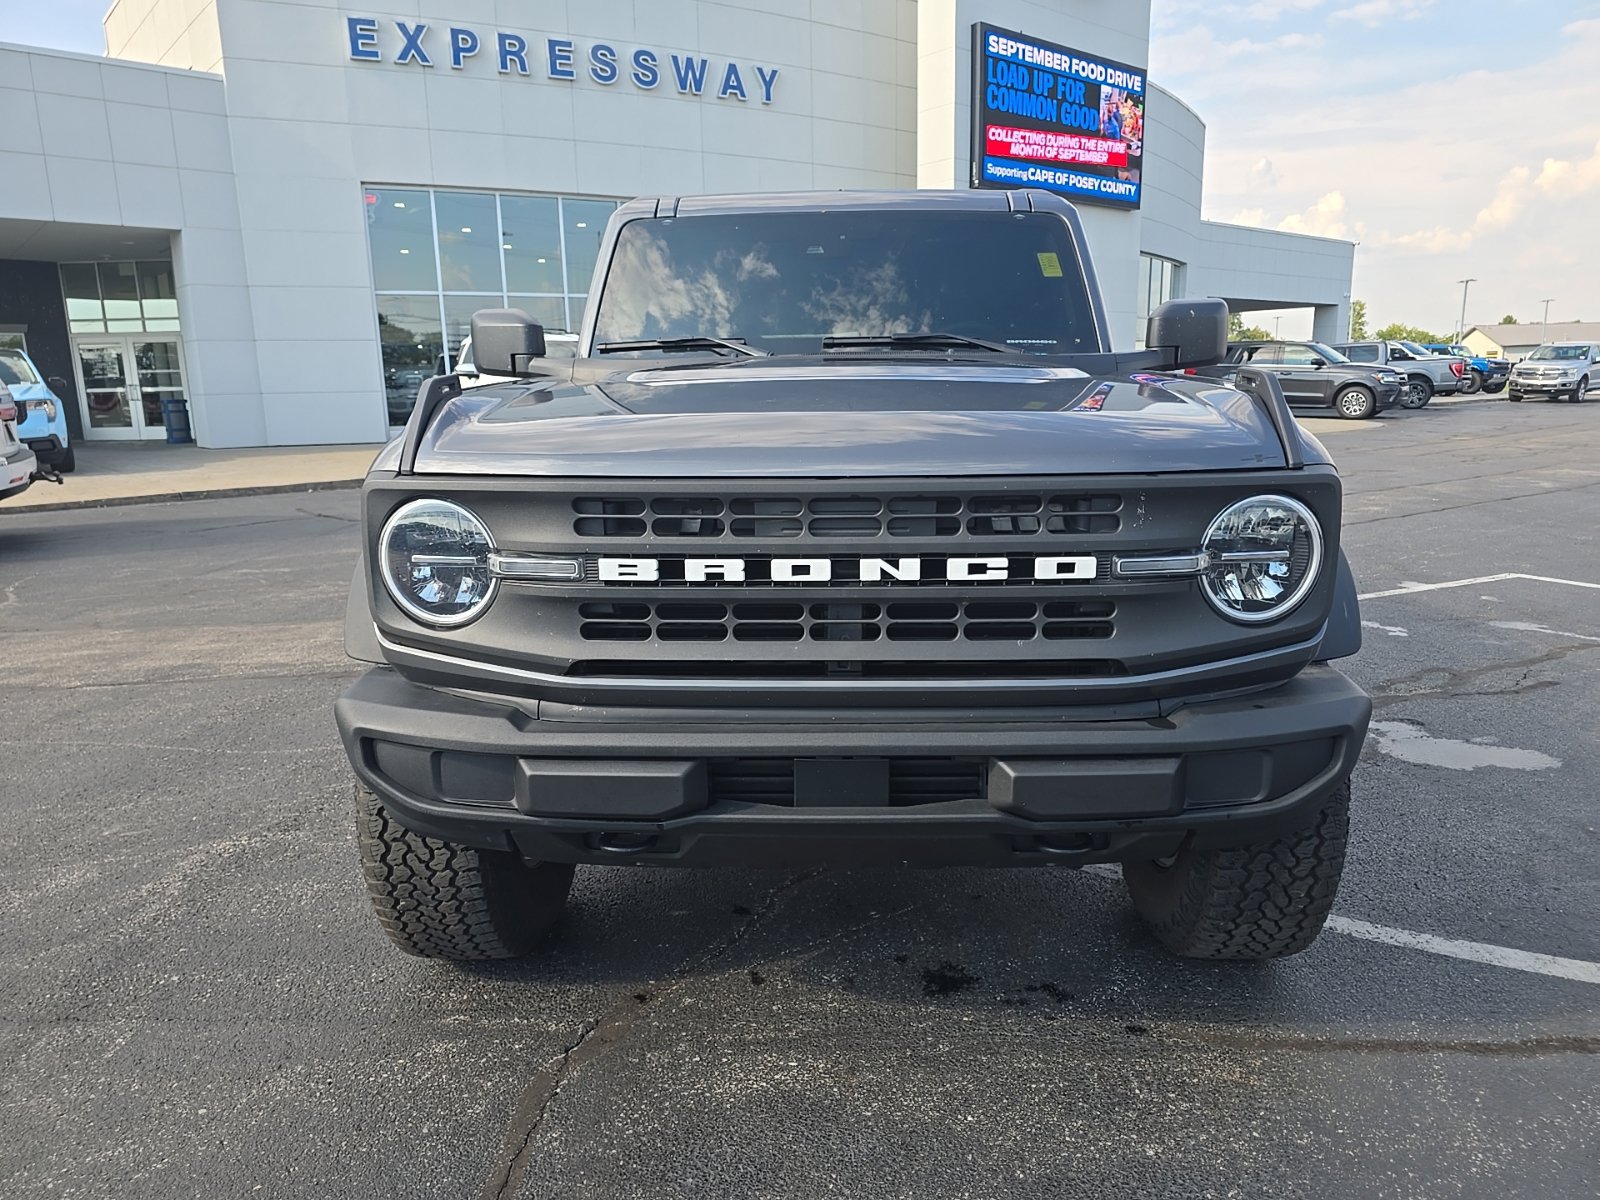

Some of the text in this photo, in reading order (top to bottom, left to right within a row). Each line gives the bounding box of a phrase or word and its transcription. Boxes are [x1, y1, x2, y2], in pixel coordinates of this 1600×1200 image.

[346, 16, 779, 104] EXPRESSWAY
[988, 35, 1142, 91] SEPTEMBER FOOD DRIVE
[987, 57, 1086, 105] LOAD UP FOR
[986, 84, 1099, 131] COMMON GOOD
[989, 128, 1127, 154] COLLECTING DURING THE ENTIRE
[1010, 143, 1109, 163] MONTH OF SEPTEMBER
[986, 163, 1028, 181] Supporting
[1028, 167, 1055, 184] CAPE
[1055, 173, 1070, 186] OF
[1069, 174, 1100, 191] POSEY
[1100, 180, 1137, 196] COUNTY
[598, 557, 1098, 582] BRONCO
